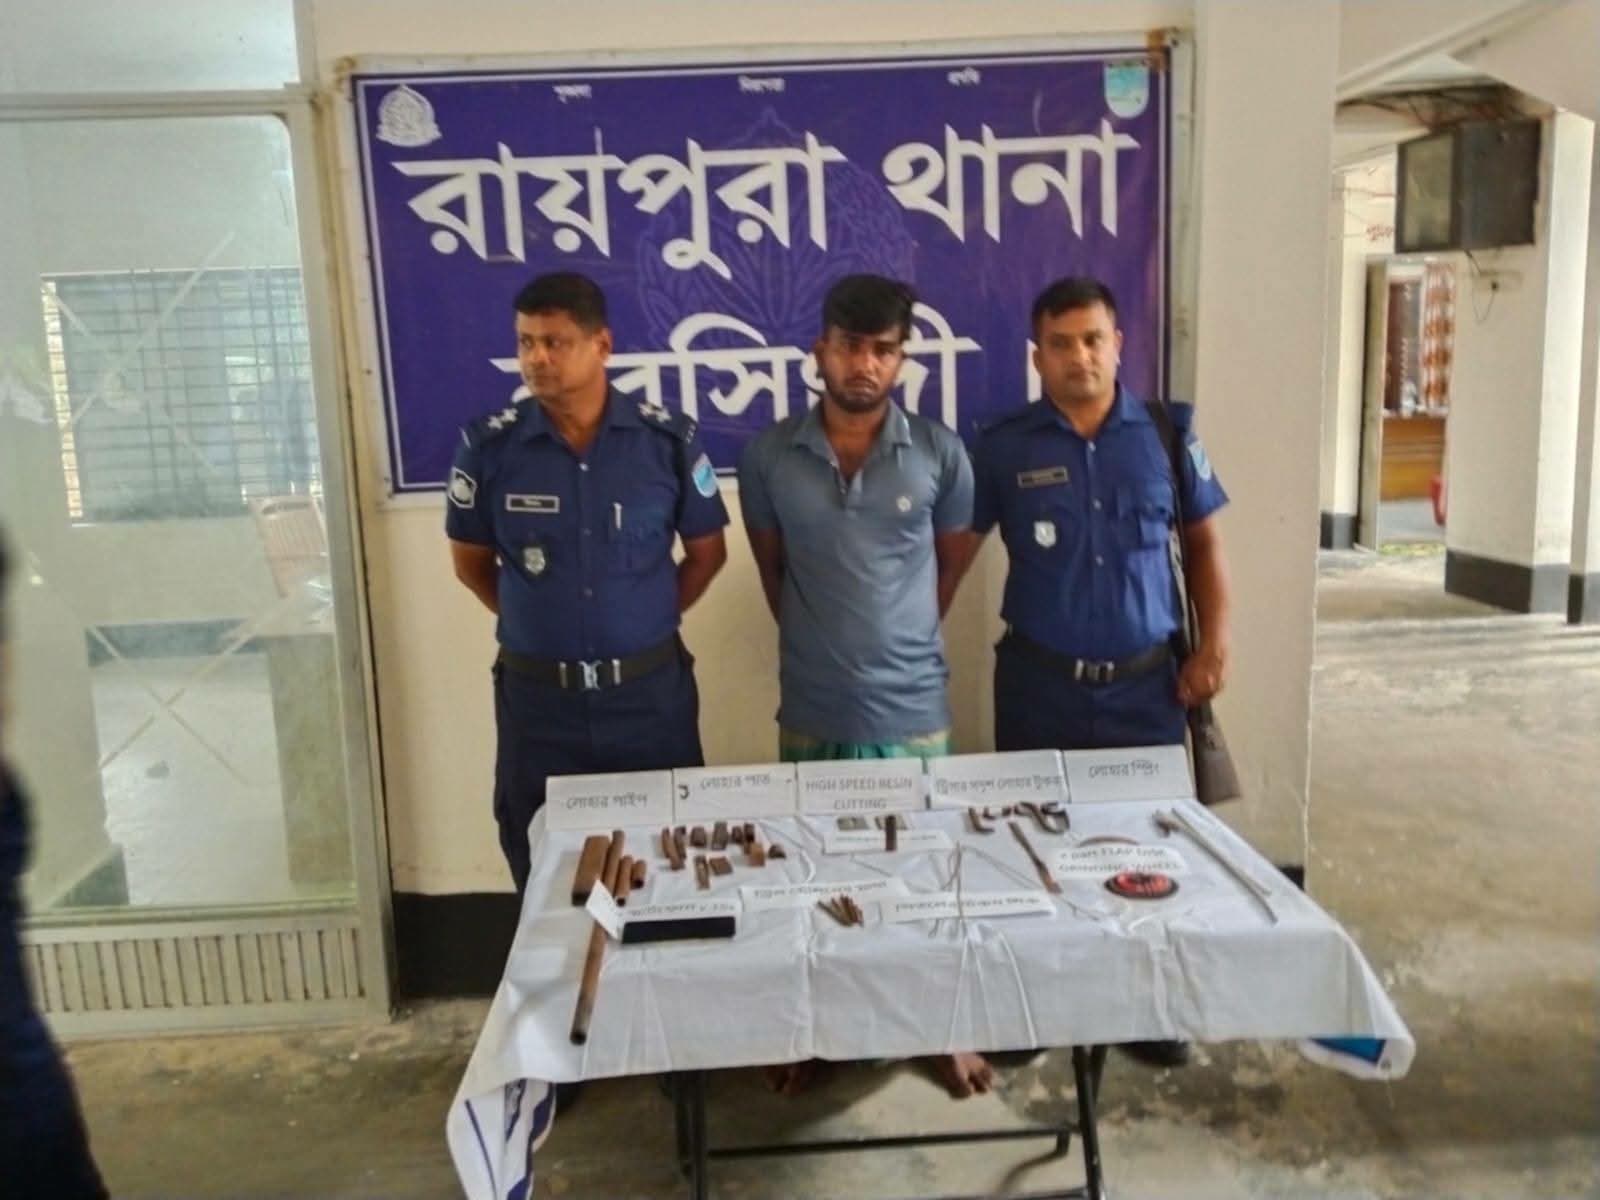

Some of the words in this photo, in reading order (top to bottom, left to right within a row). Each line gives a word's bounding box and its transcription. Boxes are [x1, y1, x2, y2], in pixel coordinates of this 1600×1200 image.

[391, 128, 848, 280] রায়পুরা
[881, 118, 1141, 244] থানা
[806, 778, 837, 792] HIGH
[840, 777, 876, 791] SPEED
[834, 797, 888, 810] CUTTING
